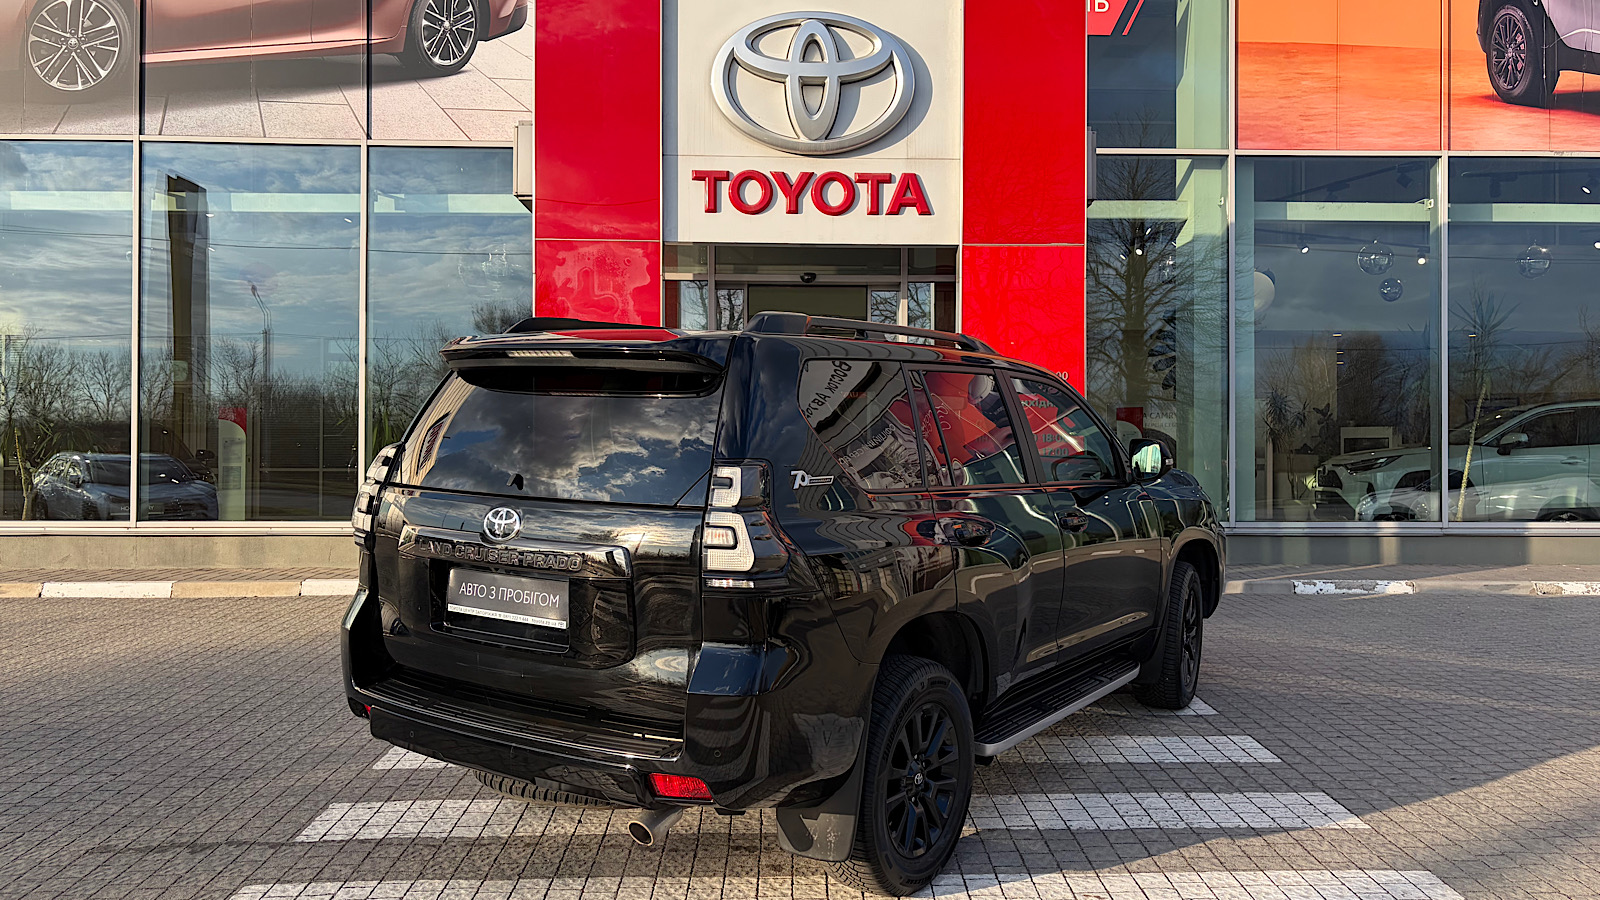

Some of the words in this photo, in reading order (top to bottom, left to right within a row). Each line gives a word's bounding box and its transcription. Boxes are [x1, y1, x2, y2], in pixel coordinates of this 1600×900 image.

[692, 170, 932, 216] TOYOTA
[418, 538, 453, 557] LAND
[454, 543, 520, 566] CRUISER
[522, 553, 583, 572] PRADO
[458, 581, 487, 598] АВТО
[498, 587, 560, 608] ПРОБІГОМ
